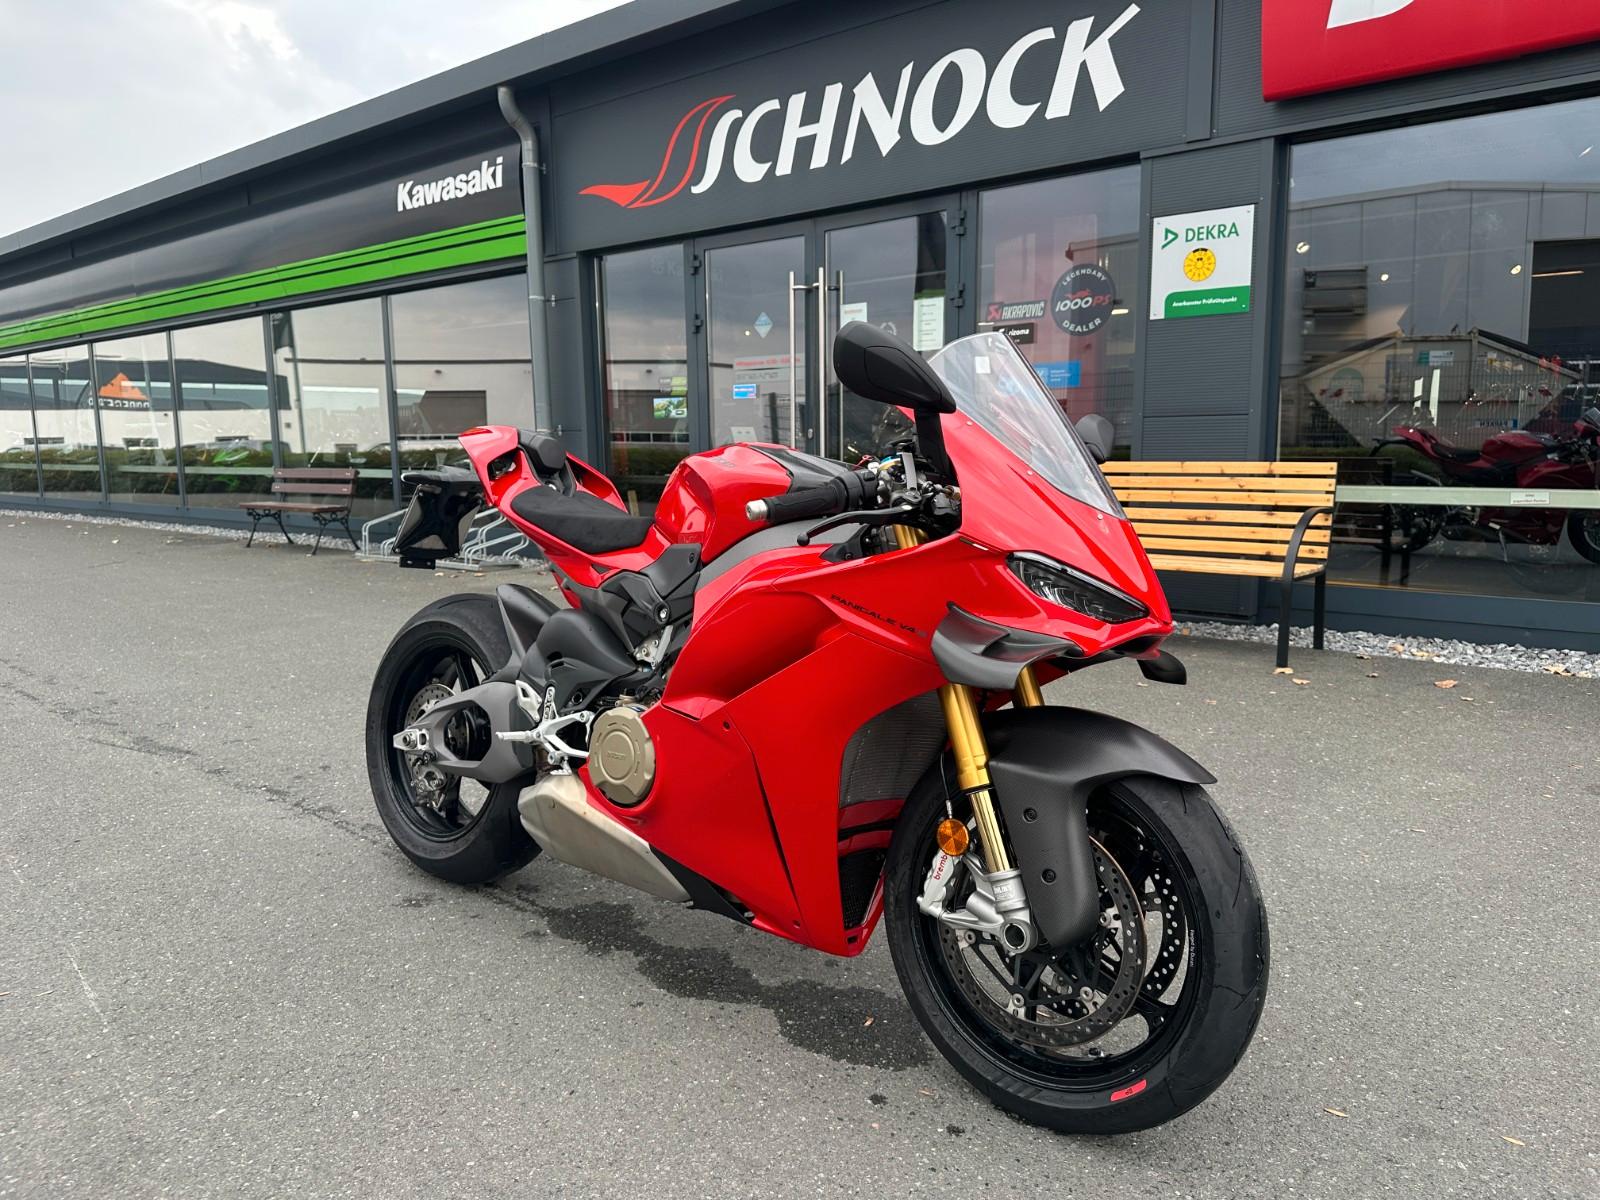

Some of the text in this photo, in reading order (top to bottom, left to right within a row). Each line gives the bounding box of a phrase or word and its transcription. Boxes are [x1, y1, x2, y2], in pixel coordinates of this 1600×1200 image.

[690, 3, 1141, 194] SCHNOCK
[397, 156, 503, 212] Kawasaki
[1185, 222, 1239, 242] DEKRA
[1062, 268, 1107, 286] LEGENDARY
[1008, 327, 1030, 336] rizoma
[1062, 318, 1102, 333] DEALER
[934, 854, 948, 881] bremb
